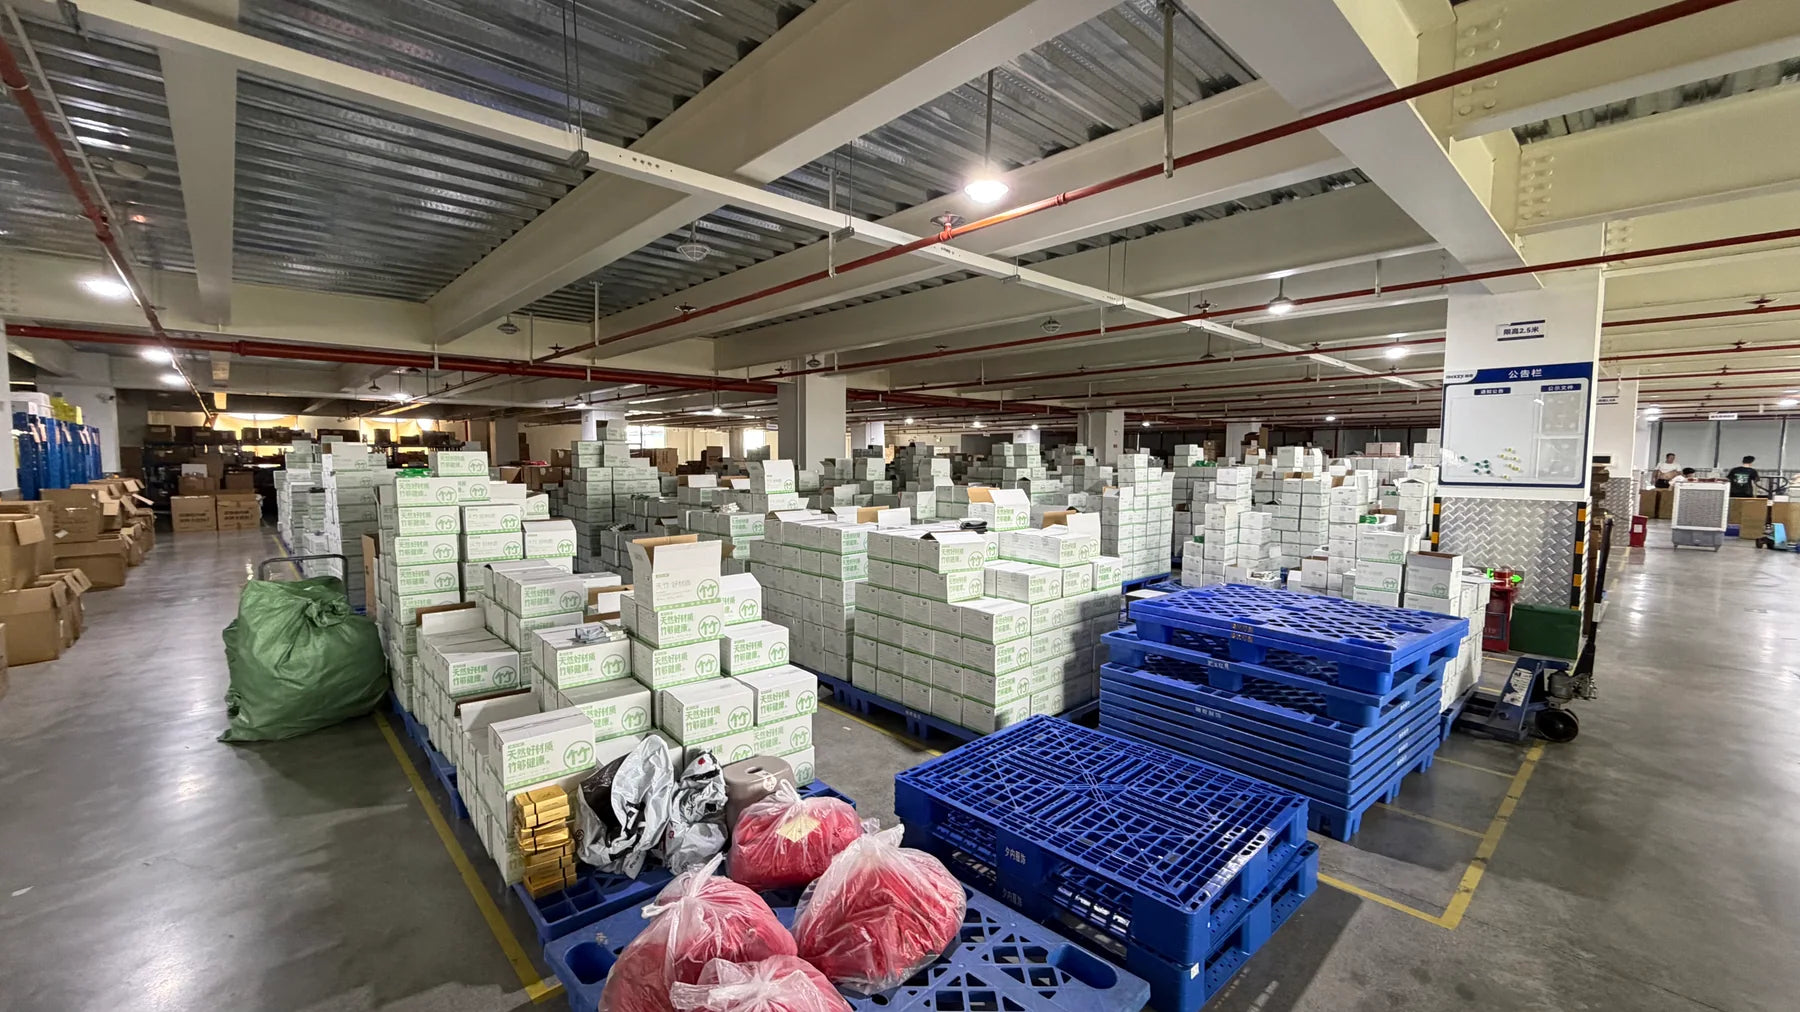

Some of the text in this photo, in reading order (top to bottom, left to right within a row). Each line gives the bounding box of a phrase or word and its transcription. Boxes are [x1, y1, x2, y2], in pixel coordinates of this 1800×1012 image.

[1503, 327, 1539, 335] 限高2.5米
[1508, 368, 1543, 379] 公告栏
[508, 740, 554, 761] 天然好材质
